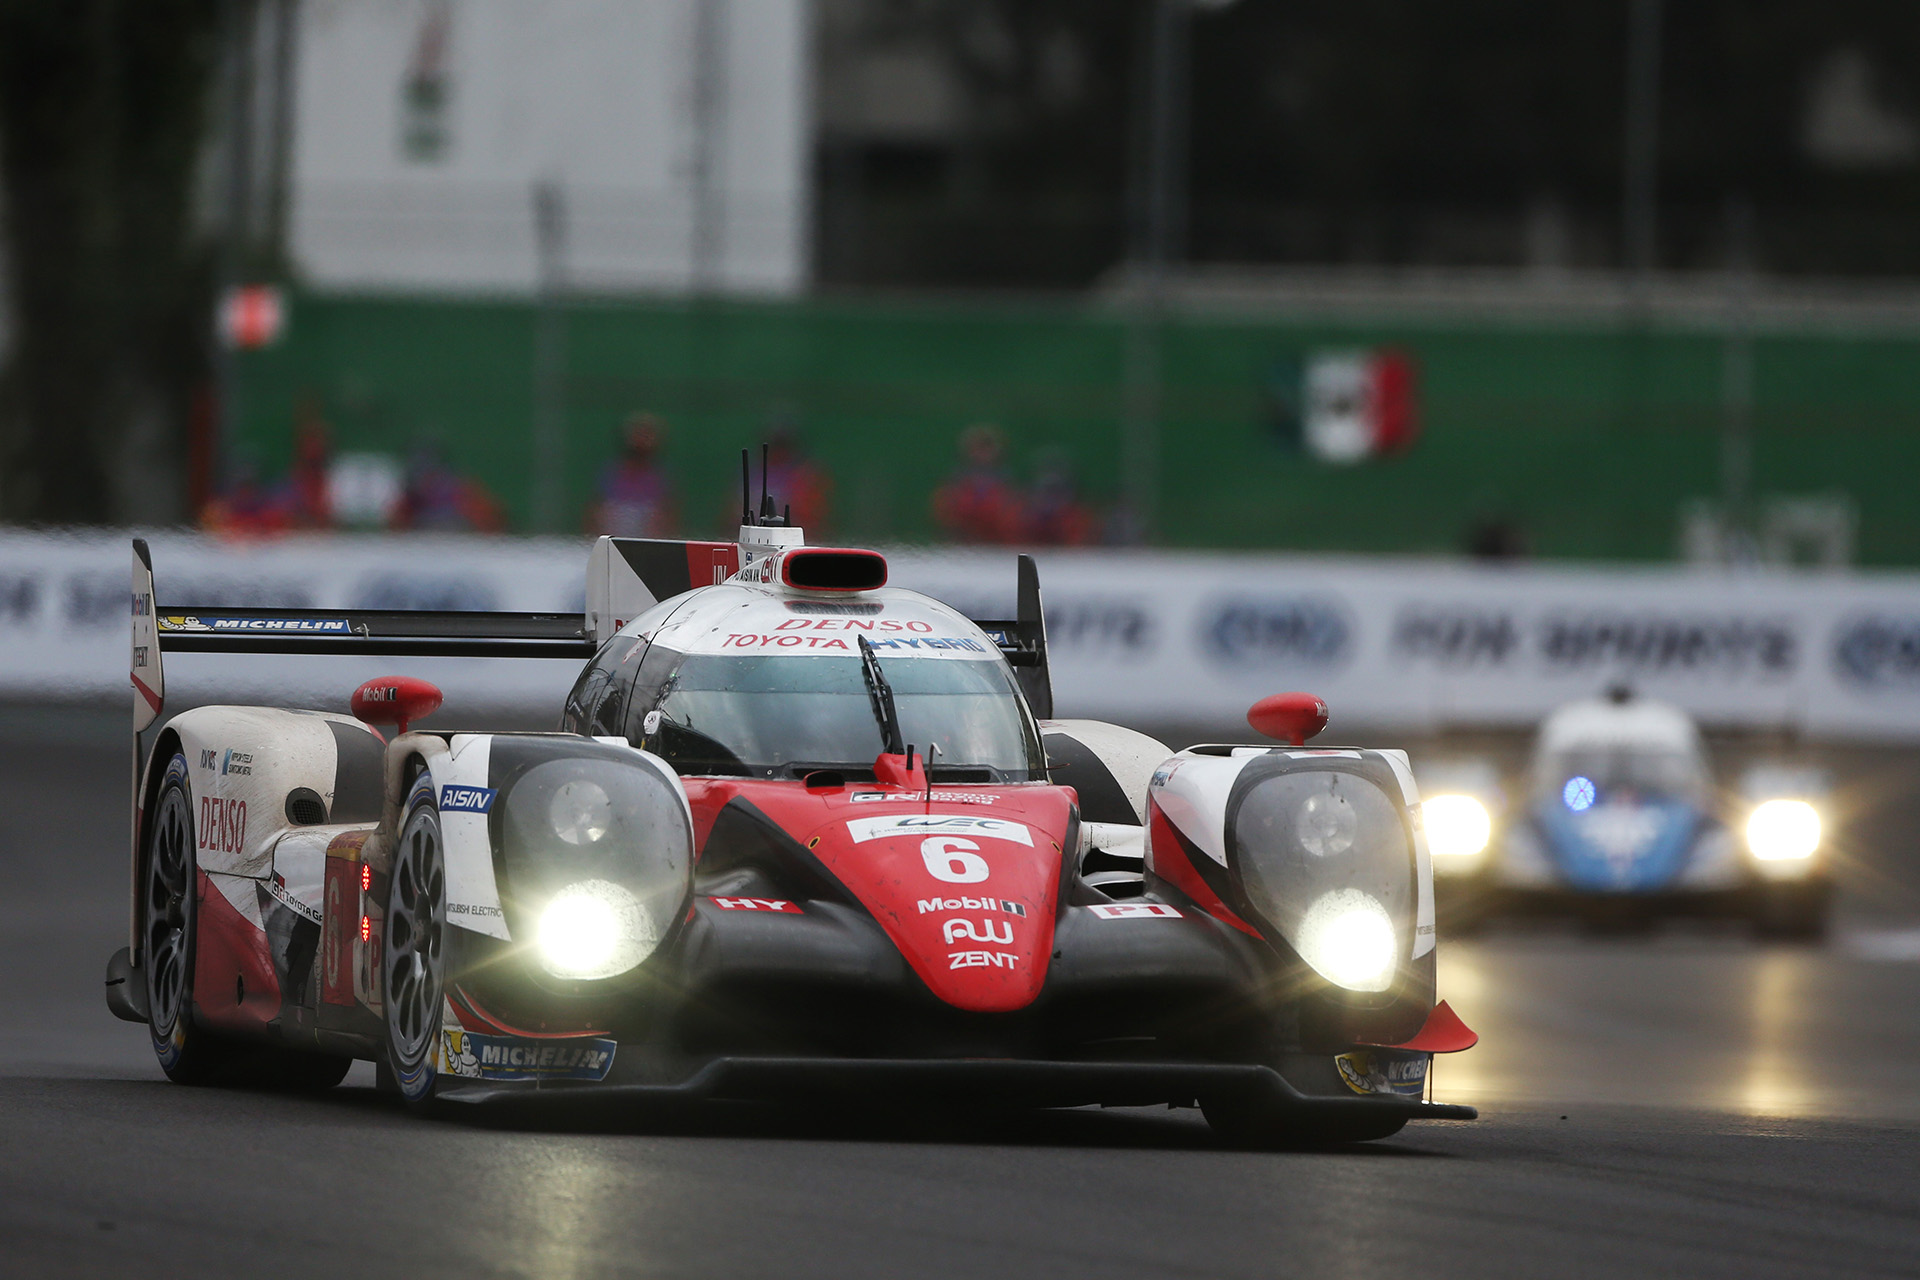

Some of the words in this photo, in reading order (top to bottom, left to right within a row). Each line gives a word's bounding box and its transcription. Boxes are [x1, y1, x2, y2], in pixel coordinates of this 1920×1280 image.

[214, 620, 343, 630] MICHELIN
[775, 619, 933, 632] DENSO
[721, 633, 850, 650] TOYOTA
[866, 637, 987, 653] HYBRID
[362, 687, 386, 702] Mobil
[442, 790, 490, 808] AISIN
[199, 796, 247, 855] DENSO
[897, 817, 1005, 829] WEC
[920, 836, 990, 884] 6
[285, 890, 311, 915] TOYOTA
[472, 906, 502, 917] ELECTRIC
[715, 898, 787, 910] HY
[917, 896, 997, 914] Mobil
[1001, 899, 1026, 918] 1
[1103, 906, 1166, 916] P1
[948, 951, 1019, 969] ZENT
[482, 1045, 609, 1069] MICHELIN
